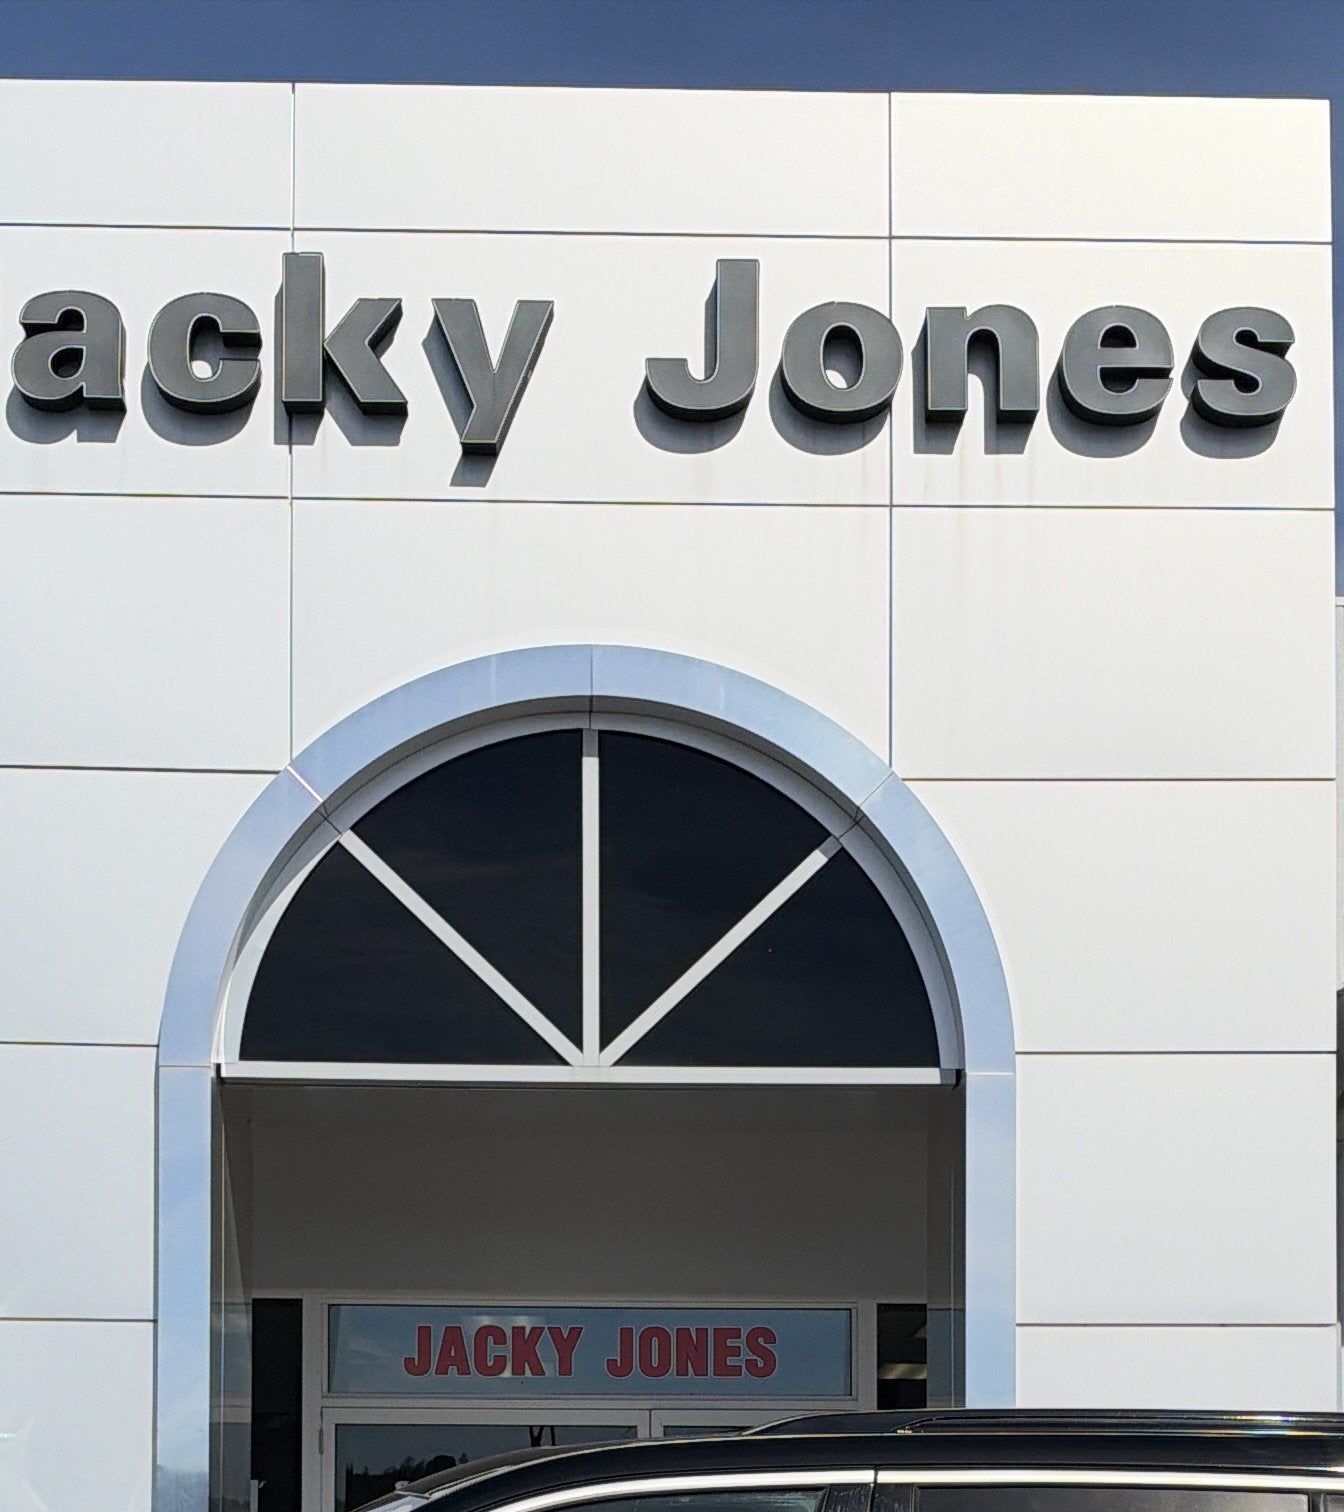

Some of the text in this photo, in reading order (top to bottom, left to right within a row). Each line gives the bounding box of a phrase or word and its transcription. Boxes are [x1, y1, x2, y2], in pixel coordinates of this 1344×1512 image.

[642, 257, 1298, 426] Jones
[403, 1323, 779, 1380] JACKY JONES
